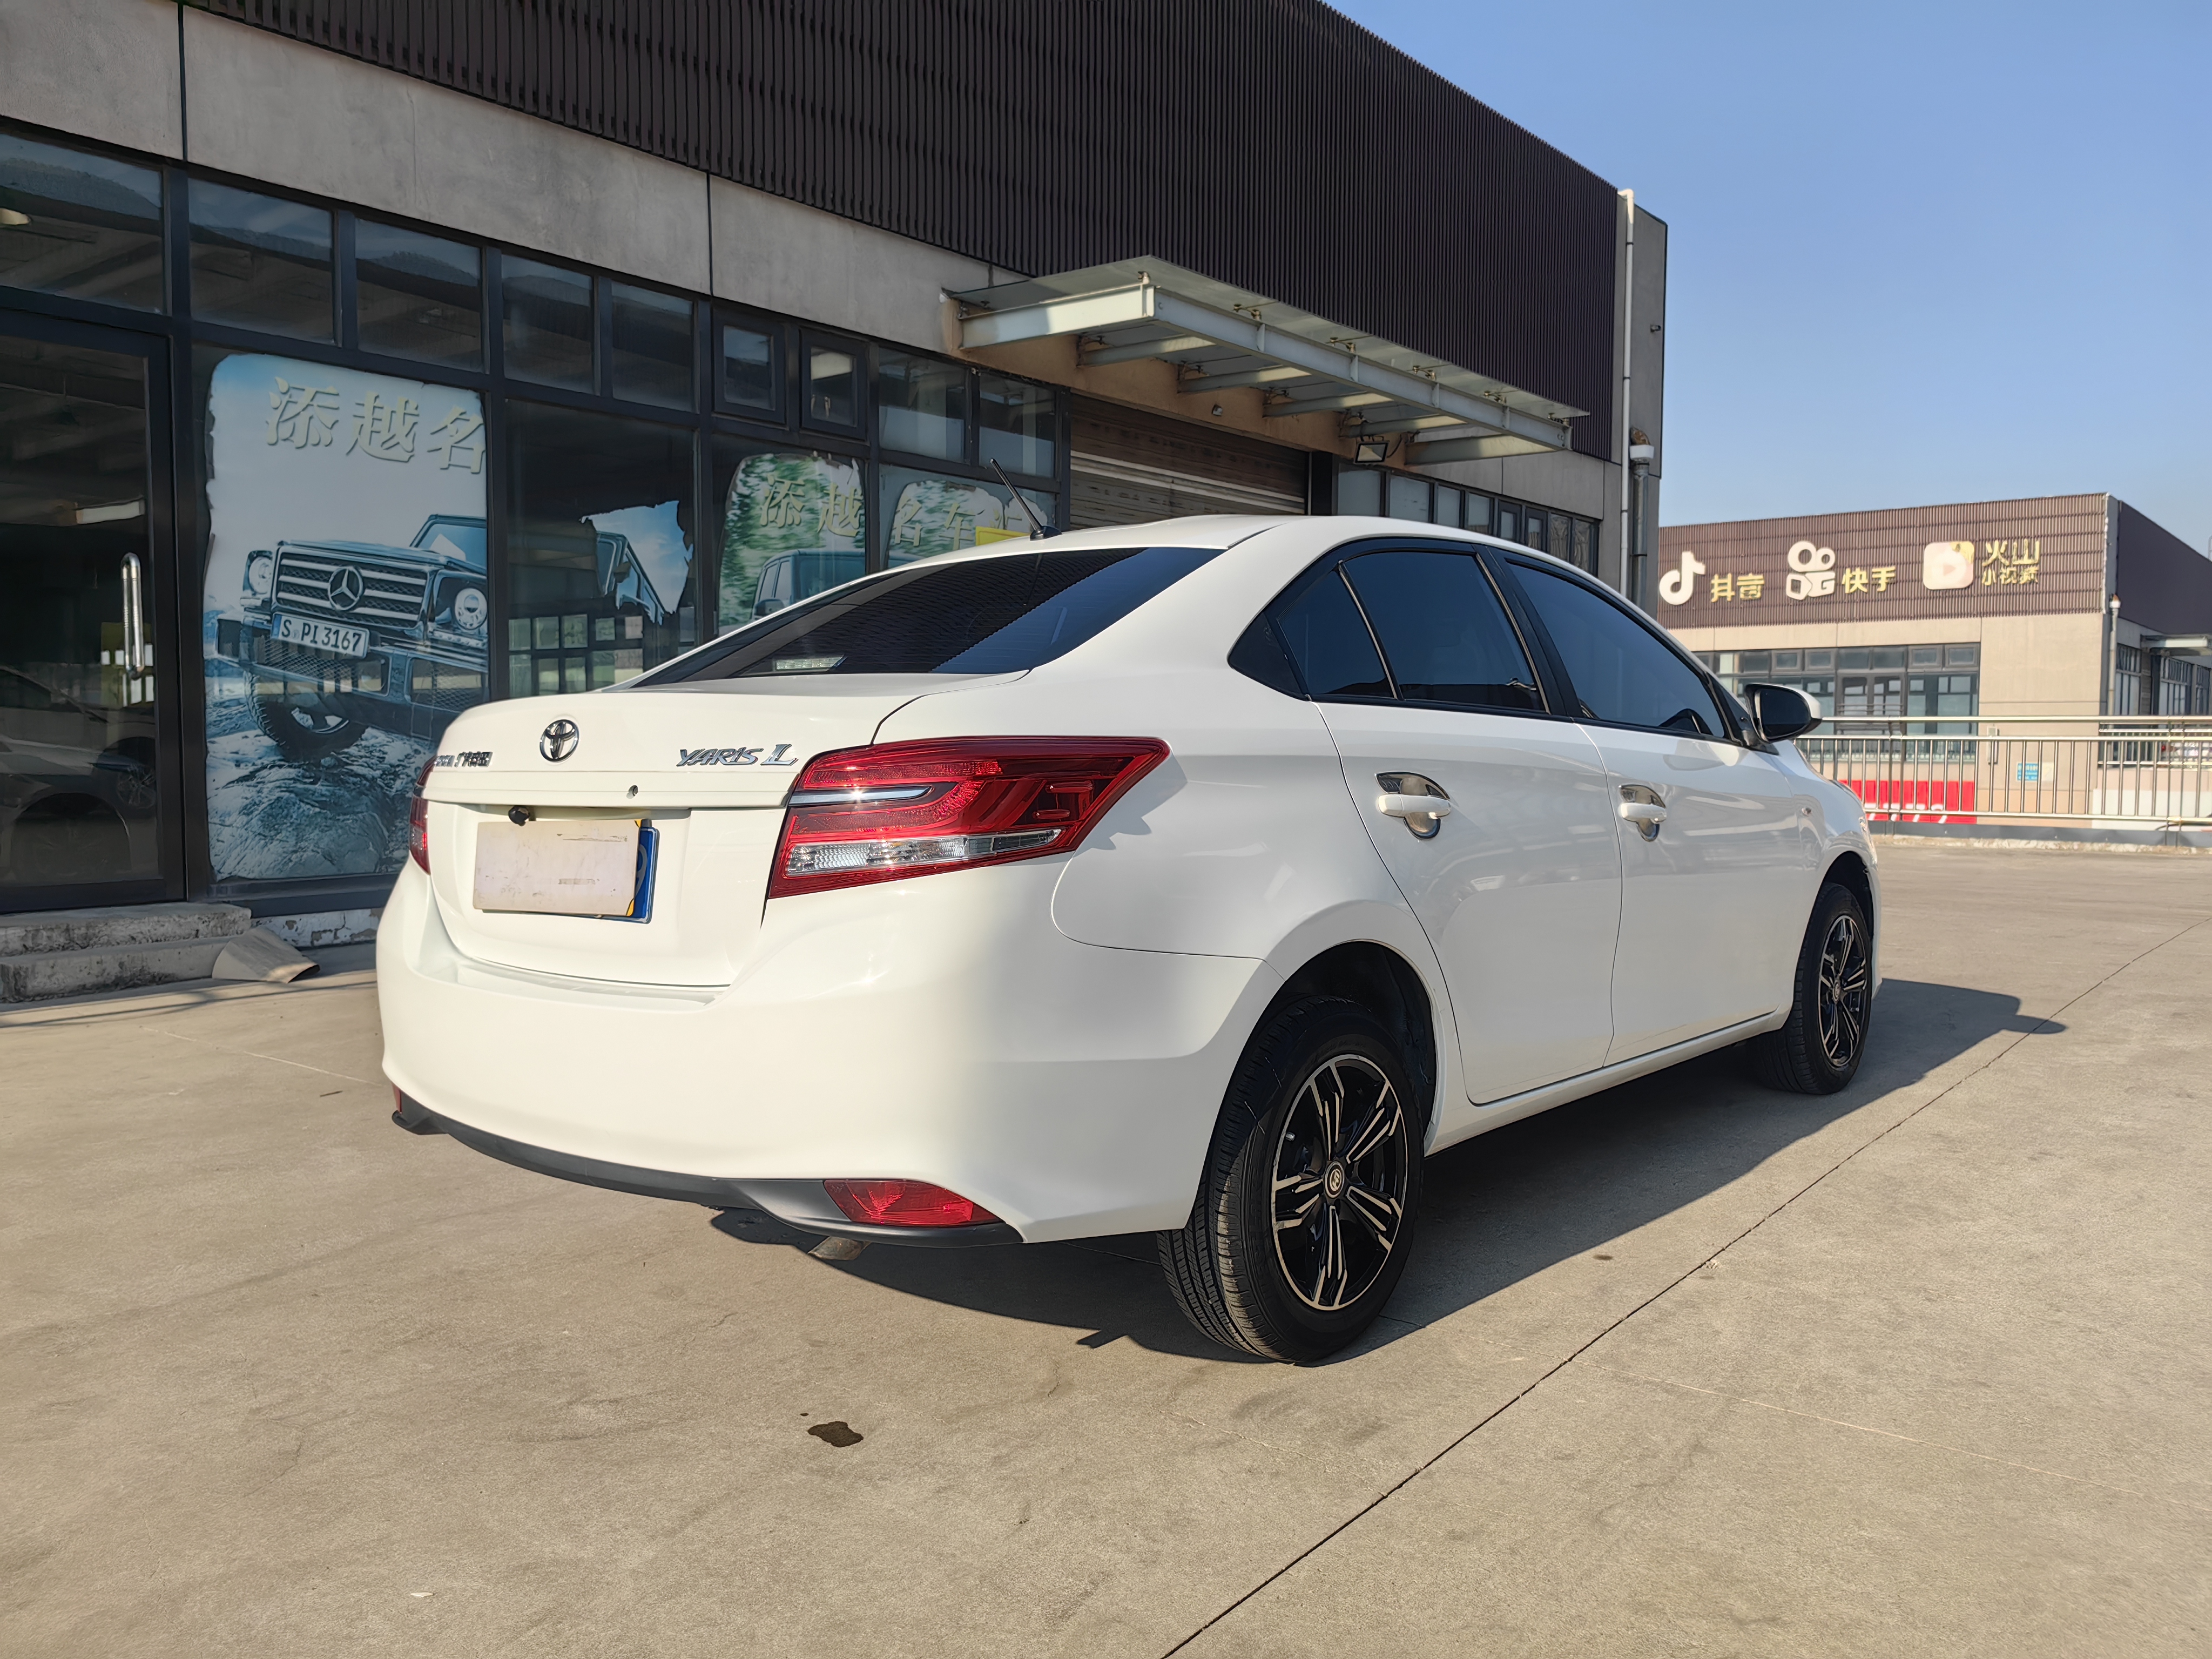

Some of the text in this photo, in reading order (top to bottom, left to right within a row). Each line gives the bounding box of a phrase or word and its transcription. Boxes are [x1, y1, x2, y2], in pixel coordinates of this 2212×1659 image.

[266, 377, 486, 474] 添越名
[1982, 538, 2040, 567] 火山
[1711, 572, 1765, 603] 抖音
[1842, 565, 1896, 594] 快手
[1981, 567, 2039, 585] 小视频
[281, 619, 292, 638] S
[322, 627, 362, 652] 3167
[676, 744, 799, 767] YARIS L
